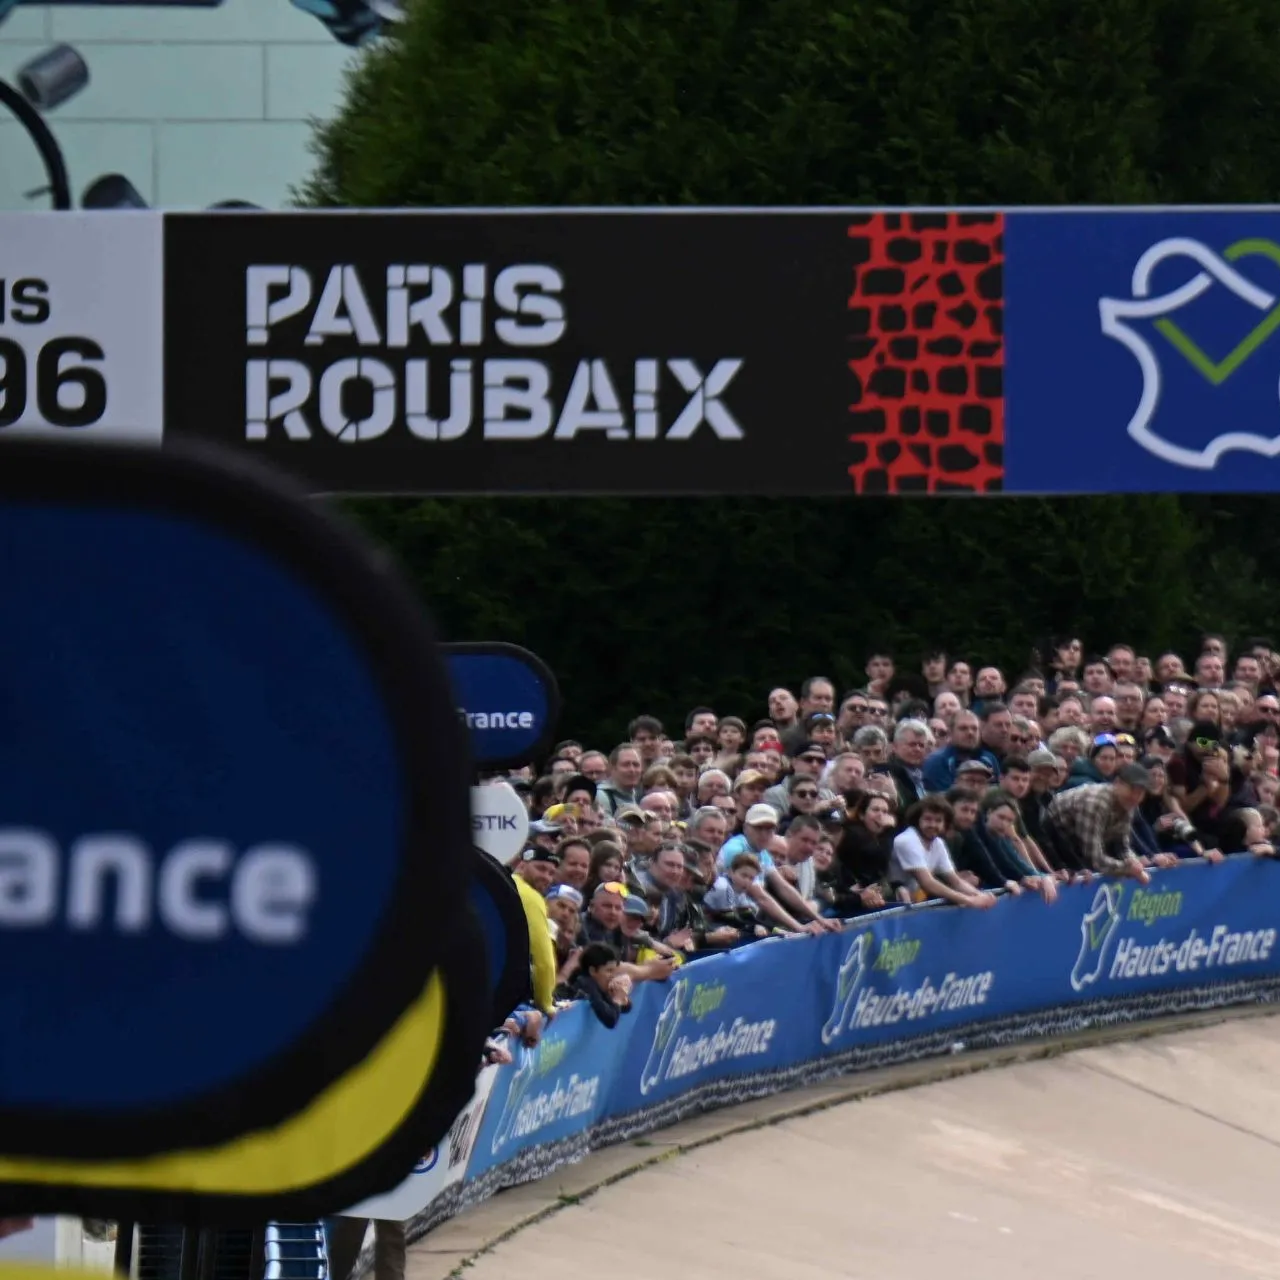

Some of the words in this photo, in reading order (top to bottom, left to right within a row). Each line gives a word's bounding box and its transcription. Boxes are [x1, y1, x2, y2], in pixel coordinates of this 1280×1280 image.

[246, 264, 567, 347] PARIS
[246, 358, 745, 442] ROUBAIX
[460, 708, 534, 729] rance
[1127, 886, 1183, 926] Région
[1109, 925, 1278, 980] Hauts-de-France
[849, 969, 994, 1032] Hauts-de-France
